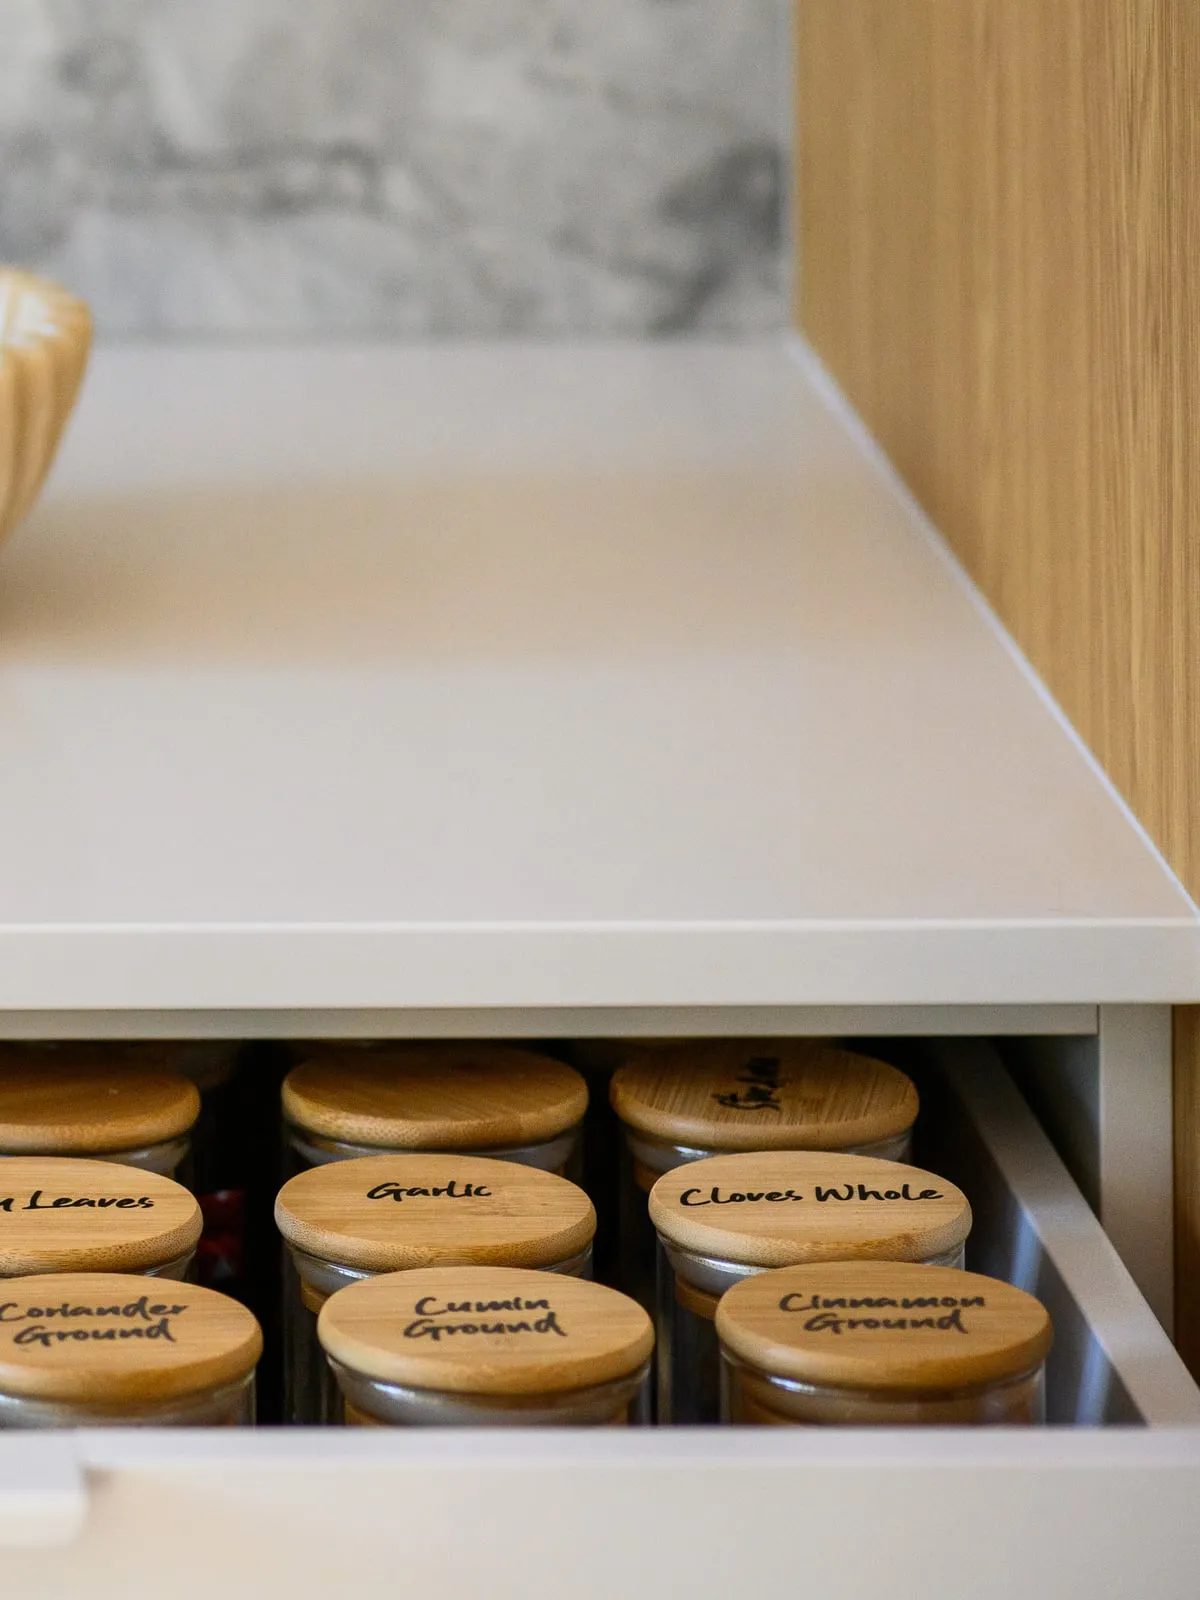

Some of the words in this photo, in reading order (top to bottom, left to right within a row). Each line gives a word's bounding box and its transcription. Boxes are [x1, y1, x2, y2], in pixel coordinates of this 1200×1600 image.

[22, 1190, 155, 1211] Leaves
[367, 1181, 492, 1202] Garlic
[680, 1187, 804, 1207] Cloves
[815, 1184, 944, 1202] Whole
[415, 1297, 550, 1317] Cumin
[779, 1292, 986, 1313] Cinnamon
[13, 1318, 177, 1347] Ground
[403, 1311, 567, 1341] Ground
[803, 1309, 969, 1335] Ground
